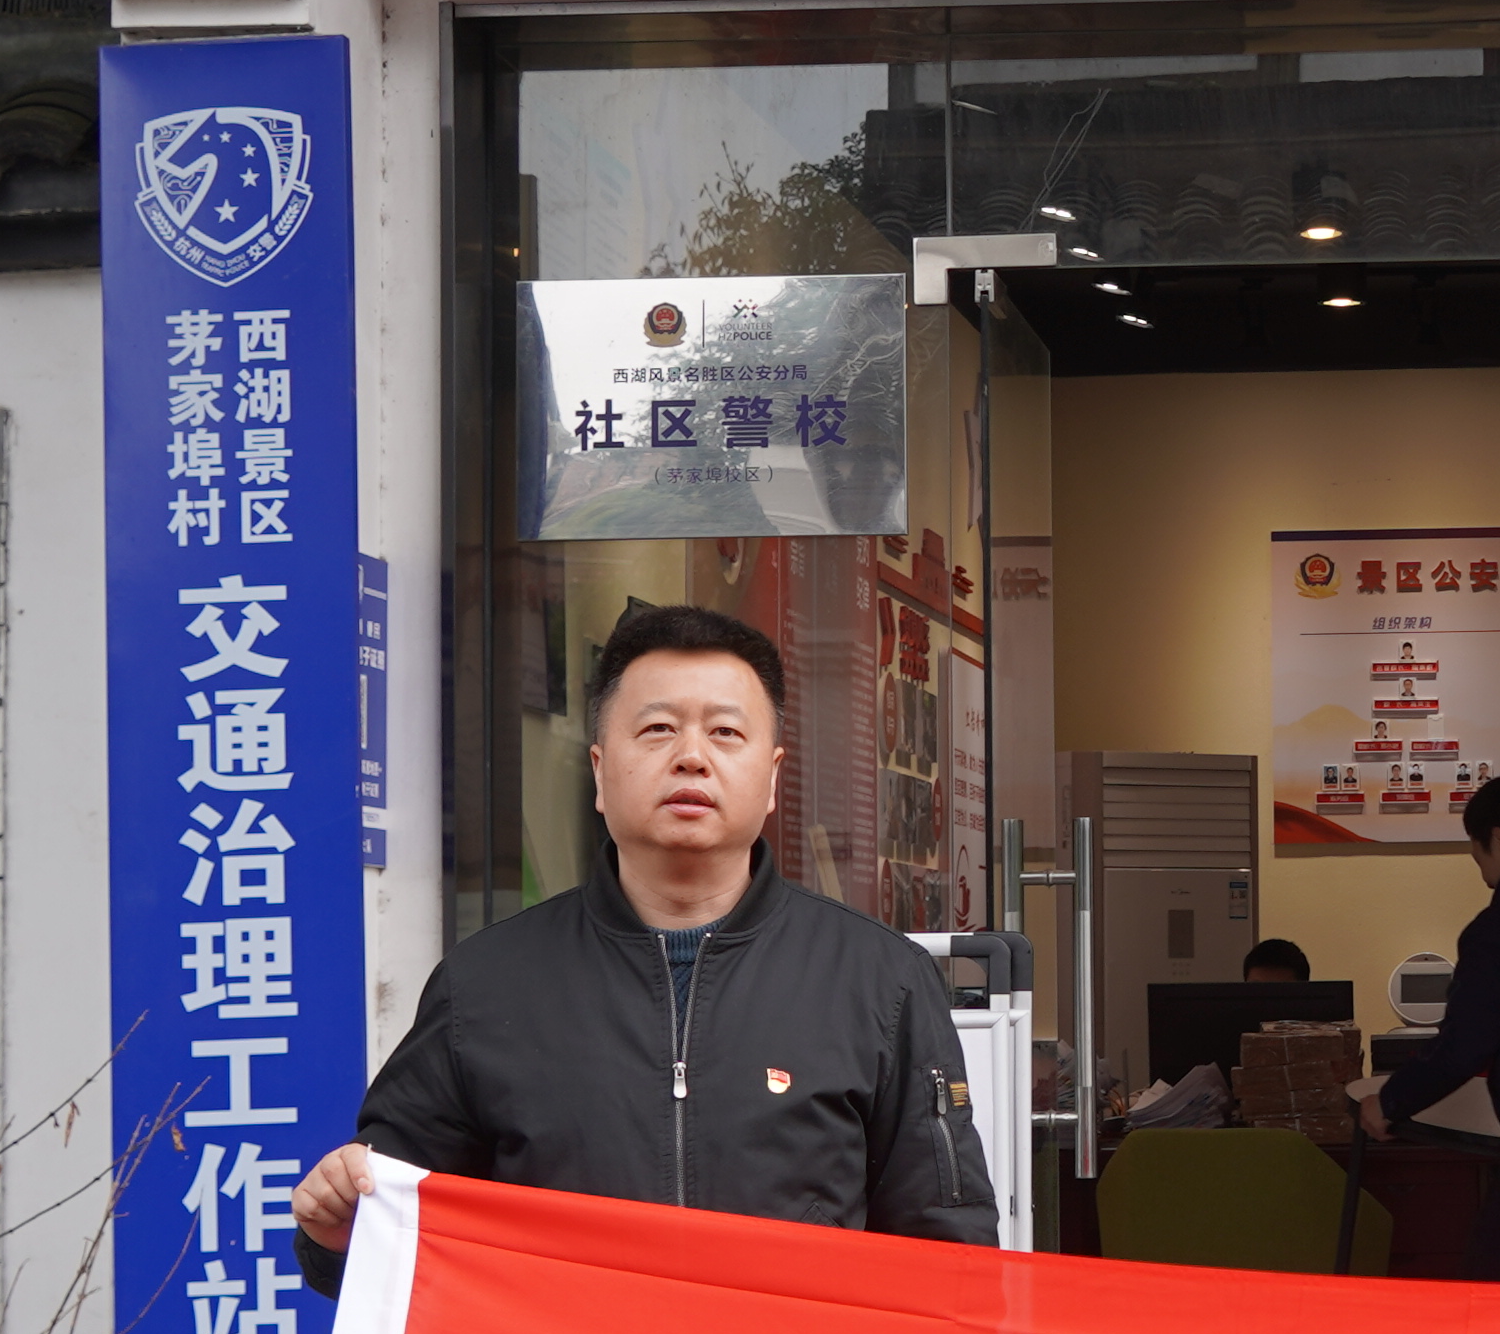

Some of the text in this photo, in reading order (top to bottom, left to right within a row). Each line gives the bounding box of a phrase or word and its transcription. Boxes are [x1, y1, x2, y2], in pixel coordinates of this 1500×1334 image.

[718, 322, 773, 332] VOLUNTEER
[718, 331, 773, 342] HZPOLICE
[613, 365, 808, 384] 西湖风景名胜区公安分局
[166, 308, 225, 548] 茅家埠村
[233, 308, 293, 544] 西湖景区
[574, 394, 847, 451] 社区警校
[1372, 616, 1432, 630] 组织架构
